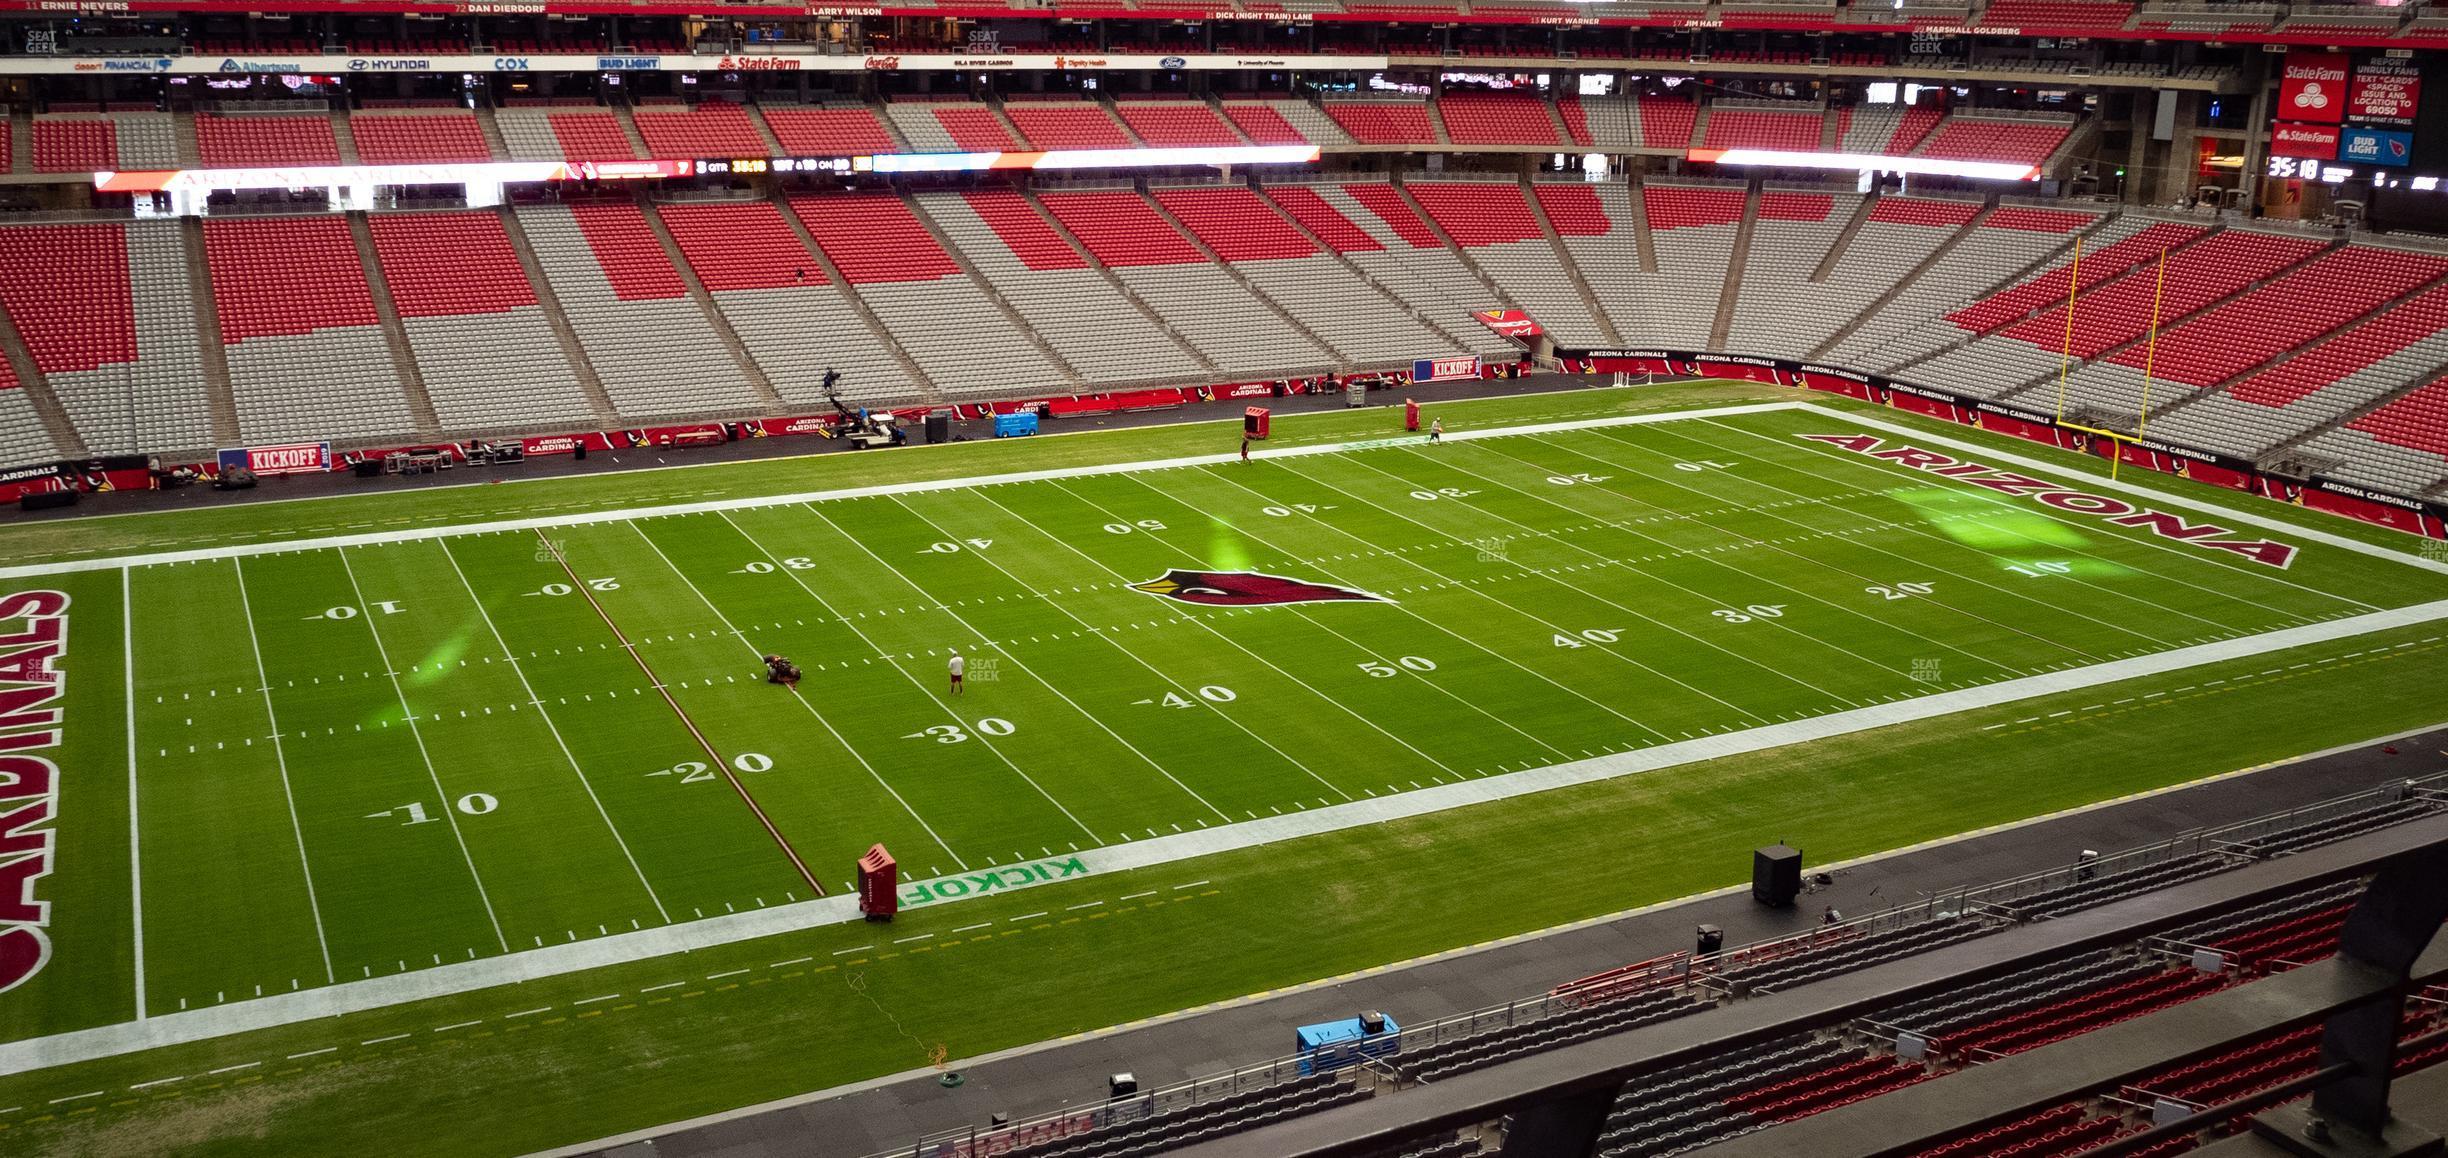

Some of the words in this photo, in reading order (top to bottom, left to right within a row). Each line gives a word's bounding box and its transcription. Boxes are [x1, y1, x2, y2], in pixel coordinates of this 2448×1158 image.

[41, 2, 78, 10] ERNIE
[80, 1, 129, 10] NEVERS
[455, 4, 467, 13] 72
[468, 4, 490, 13] DAN
[490, 4, 546, 13] DIERDORF
[804, 7, 811, 16] 8
[812, 7, 843, 16] LARRY
[844, 7, 882, 16] WILSON
[1216, 12, 1235, 20] DICK
[1235, 12, 1262, 20] (NIGHT
[1263, 12, 1292, 21] TRAIN)
[1292, 12, 1313, 21] LANE
[1541, 17, 1563, 25] KURT
[1564, 17, 1600, 25] WARNER
[1684, 20, 1698, 28] JIM
[1699, 20, 1723, 28] HART
[1925, 26, 1972, 34] MARSHALL
[1973, 27, 2020, 36] GOLDBERG
[104, 61, 152, 71] FINANCIAL
[372, 59, 430, 70] HYUNDAI
[495, 58, 529, 70] COX
[600, 59, 628, 68] BUD
[629, 59, 658, 68] LIGHT
[1068, 59, 1088, 68] Dignity
[1088, 59, 1107, 67] Health
[2370, 57, 2409, 67] REPORT
[242, 62, 300, 73] Albertsons
[2357, 65, 2393, 76] UNRULY
[2394, 67, 2420, 77] FANS
[2356, 75, 2378, 84] TEXT
[2366, 83, 2404, 92] <SPACE>
[2361, 90, 2386, 99] ISSUE
[2388, 91, 2407, 100] AND
[2354, 98, 2397, 108] LOCATION
[2399, 100, 2412, 108] TO
[2365, 106, 2398, 116] 69050
[2353, 136, 2376, 147] BUD
[2347, 144, 2379, 156] LIGHT
[708, 163, 729, 173] QTR
[1624, 351, 1668, 359] CARDINALS
[1695, 354, 1731, 363] ARIZONA
[1732, 356, 1775, 367] CARDINALS
[1433, 360, 1474, 377] KICKOFF
[1801, 365, 1834, 375] ARIZONA
[1834, 368, 1868, 382] CARDINALS
[1231, 387, 1271, 397] CARDINALS
[1889, 382, 1917, 395] ARIZONA
[1917, 389, 1955, 403] CARDINALS
[1977, 402, 2009, 415] ARIZONA
[2009, 409, 2050, 424] CARDINALS
[795, 418, 825, 426] ARIZONA
[539, 437, 573, 446] ARIZONA
[252, 449, 317, 470] KICKOFF
[2169, 446, 2217, 463] CARDINALS
[0, 466, 59, 482] ARDINALS
[2321, 482, 2365, 498] ARIZONA
[2366, 491, 2423, 510] CARDINALS
[1791, 433, 2300, 572] ARIZONA
[897, 857, 1090, 908] KICKOF
